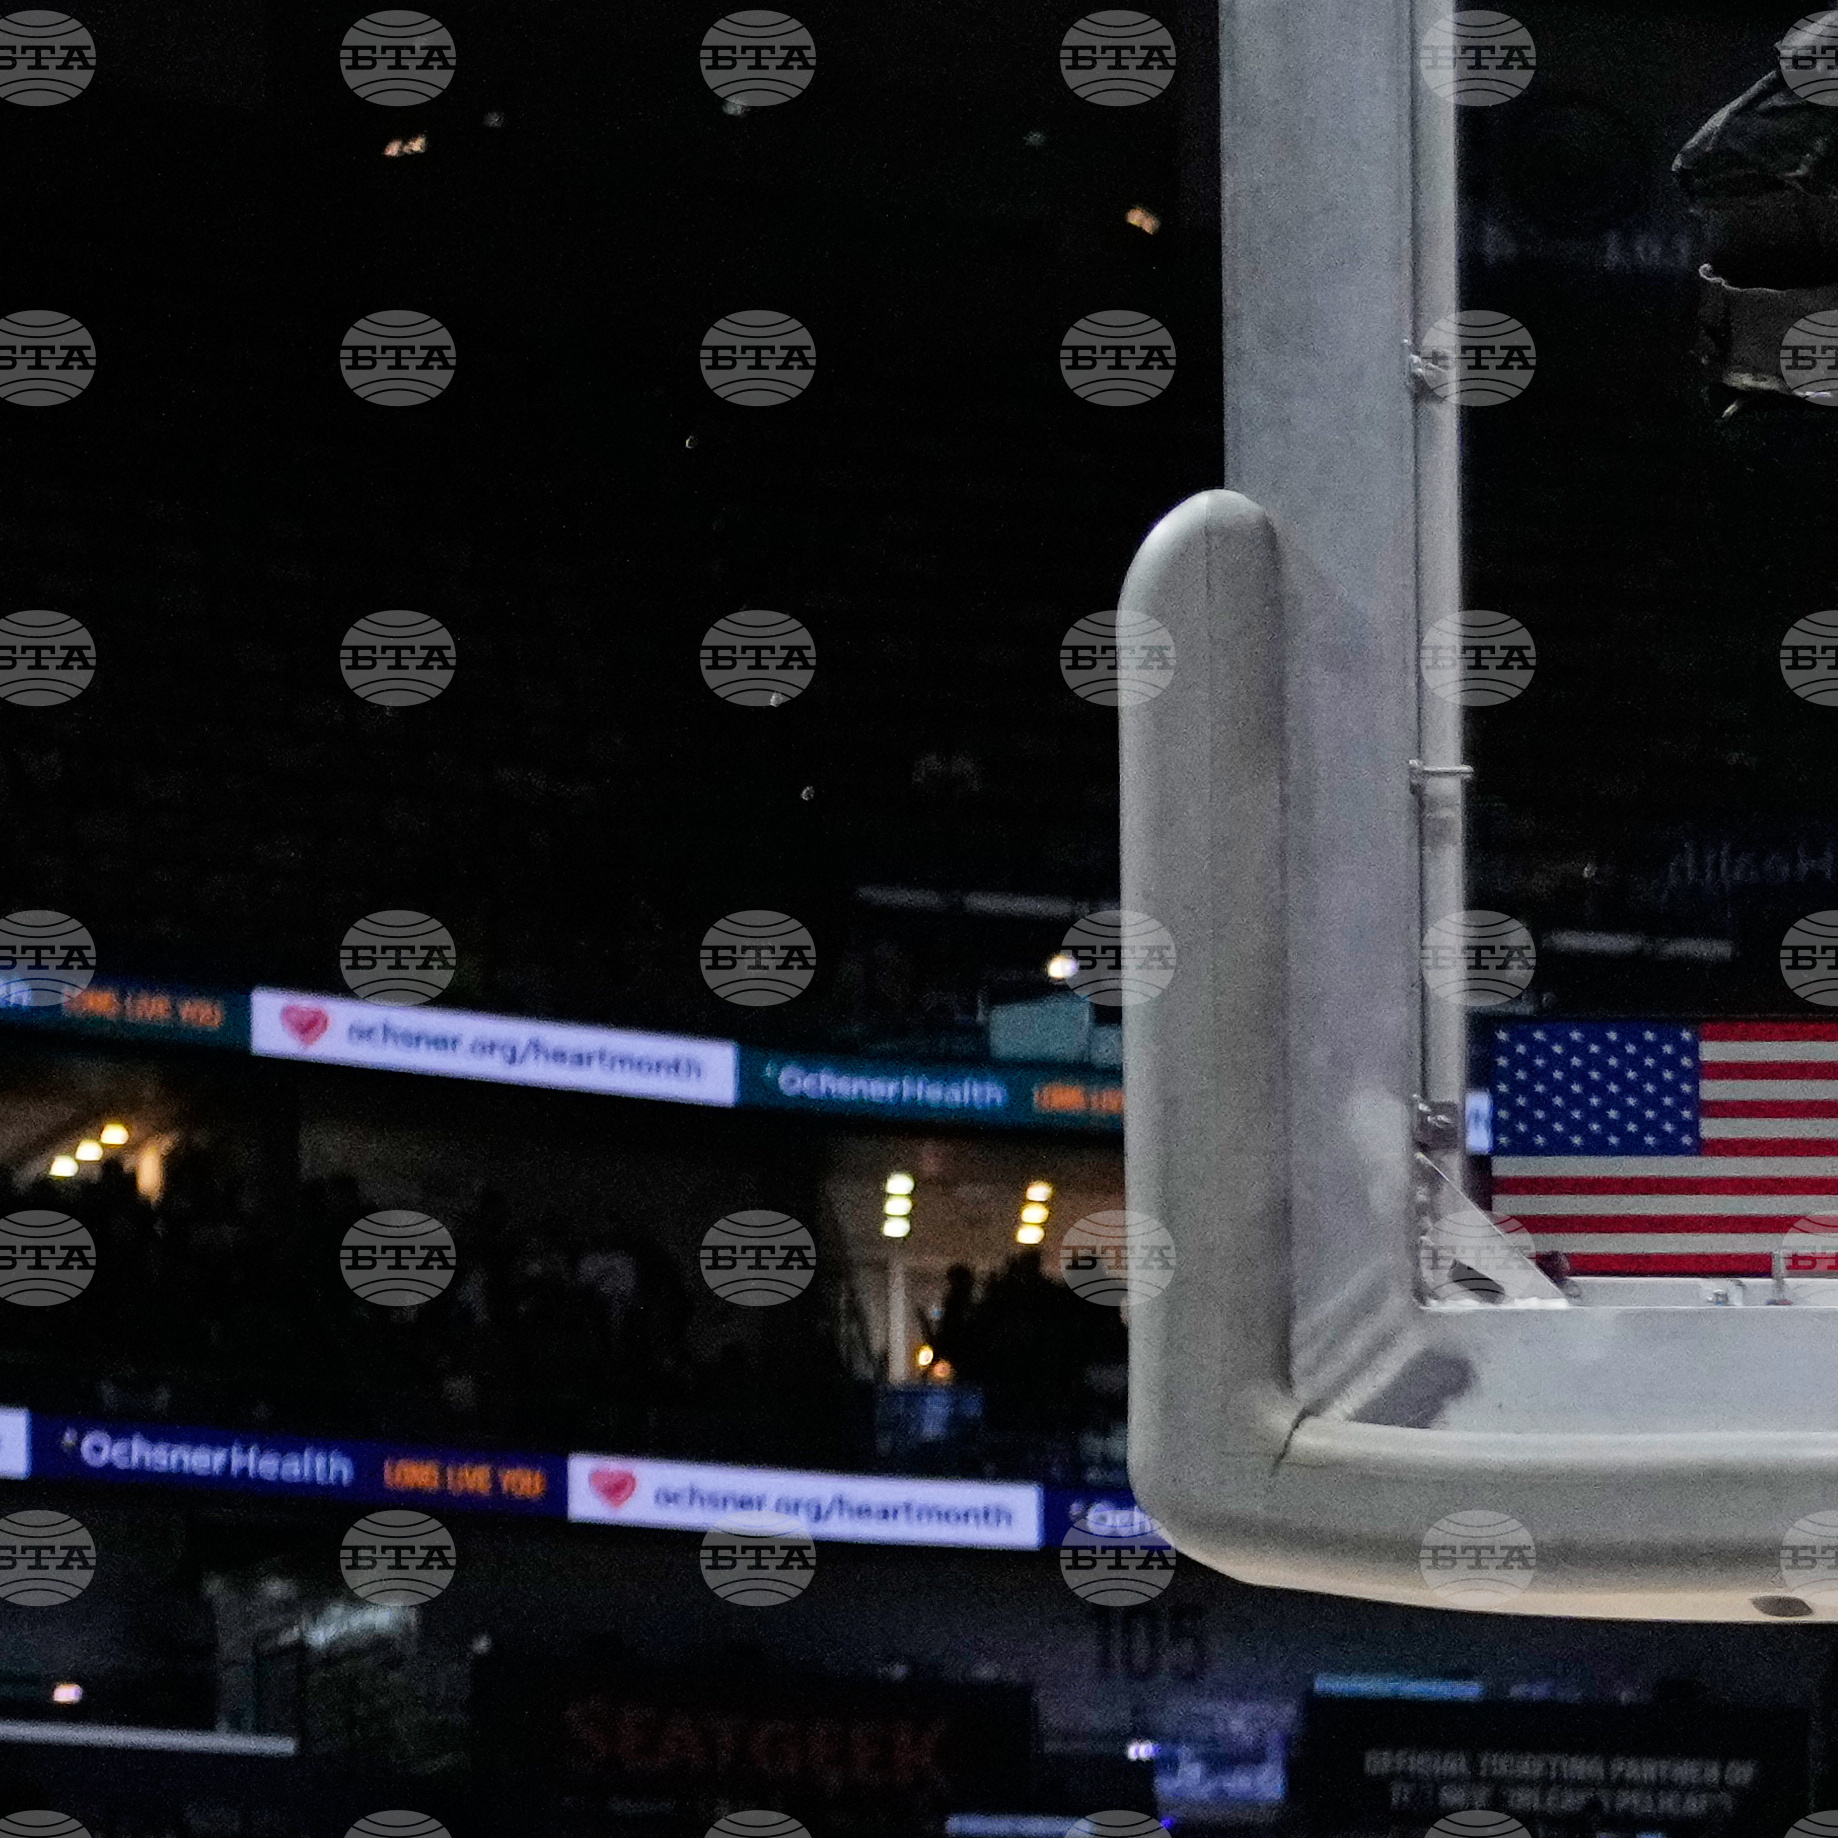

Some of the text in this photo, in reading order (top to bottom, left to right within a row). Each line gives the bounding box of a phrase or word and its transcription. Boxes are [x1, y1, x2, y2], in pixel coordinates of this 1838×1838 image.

[347, 1018, 704, 1083] ochsner.org/heartmonth
[80, 1429, 354, 1489] OchsnerHealth
[384, 1457, 547, 1498] LONG LIVE YOU
[653, 1483, 1014, 1529] ochsner.org/heartmonth
